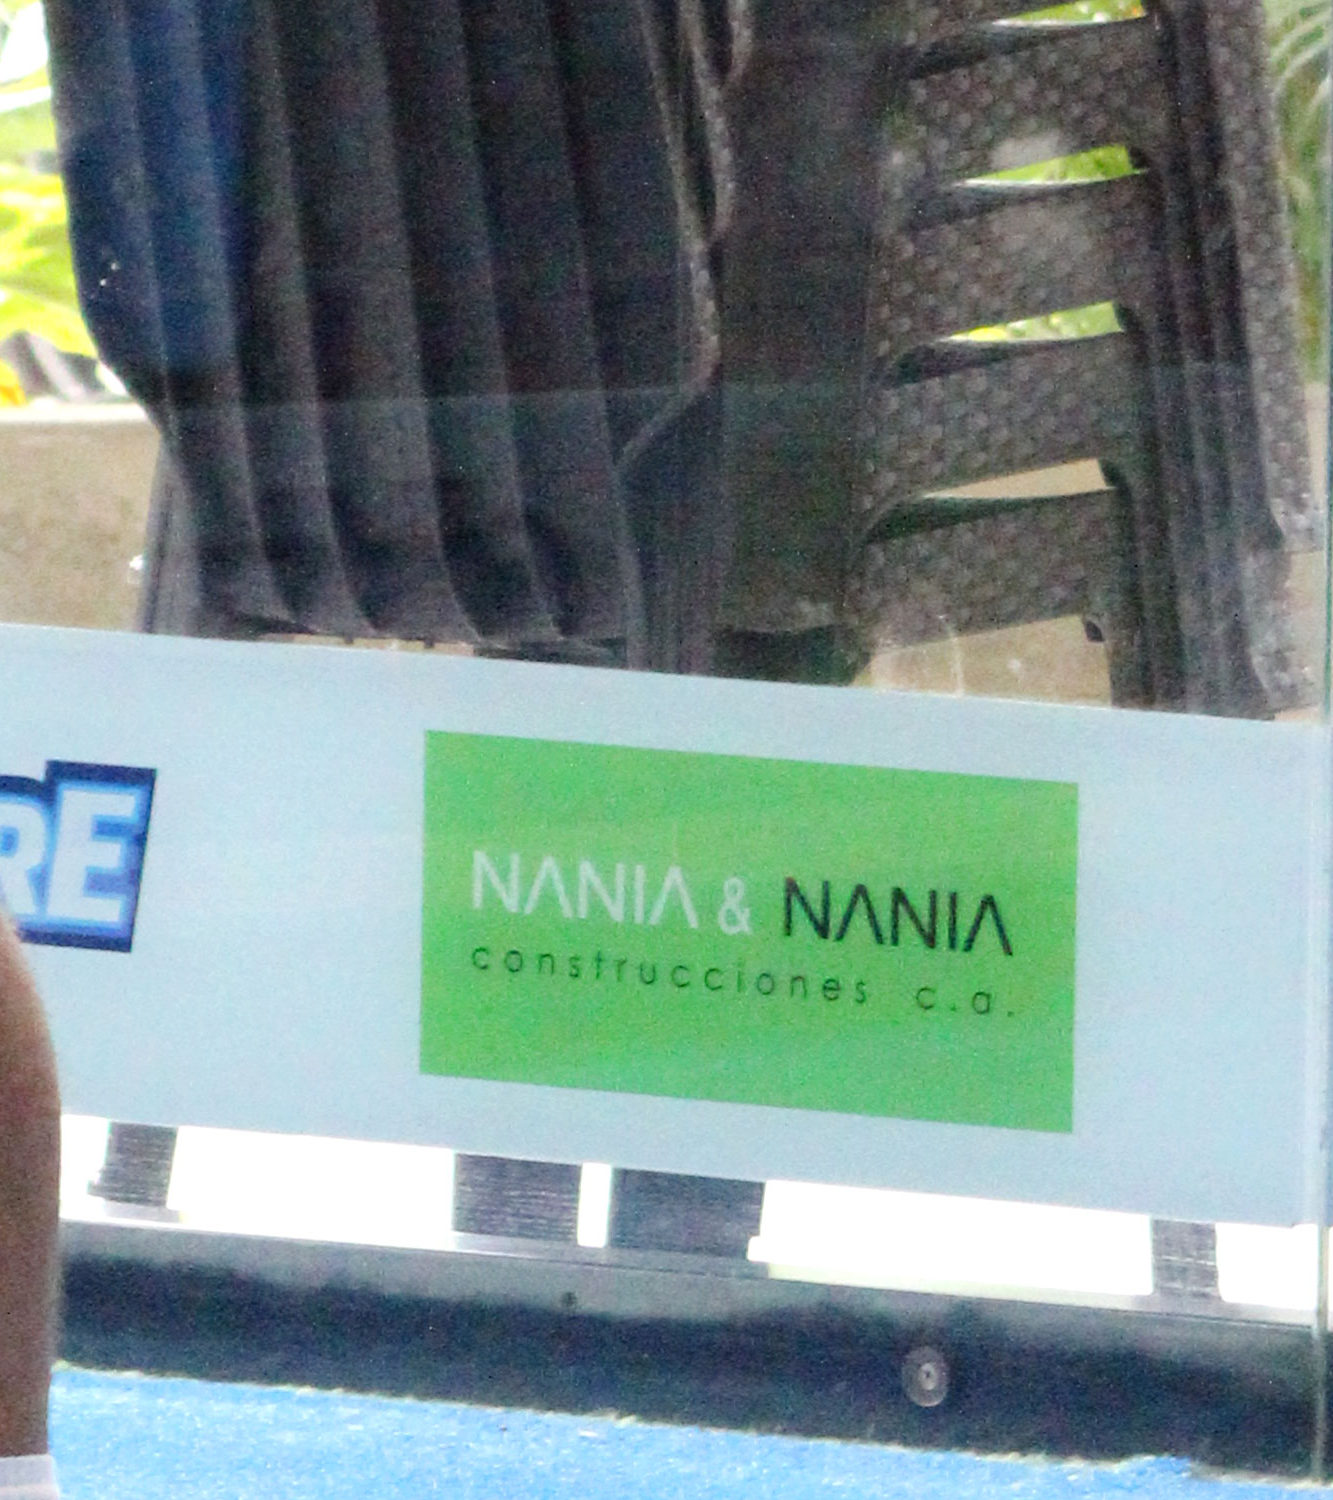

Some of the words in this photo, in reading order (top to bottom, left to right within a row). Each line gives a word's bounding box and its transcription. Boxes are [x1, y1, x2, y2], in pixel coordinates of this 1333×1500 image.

[471, 849, 699, 930] NANIA
[717, 875, 754, 937] &
[782, 874, 1015, 957] NANIA
[470, 944, 868, 1006] construcciones
